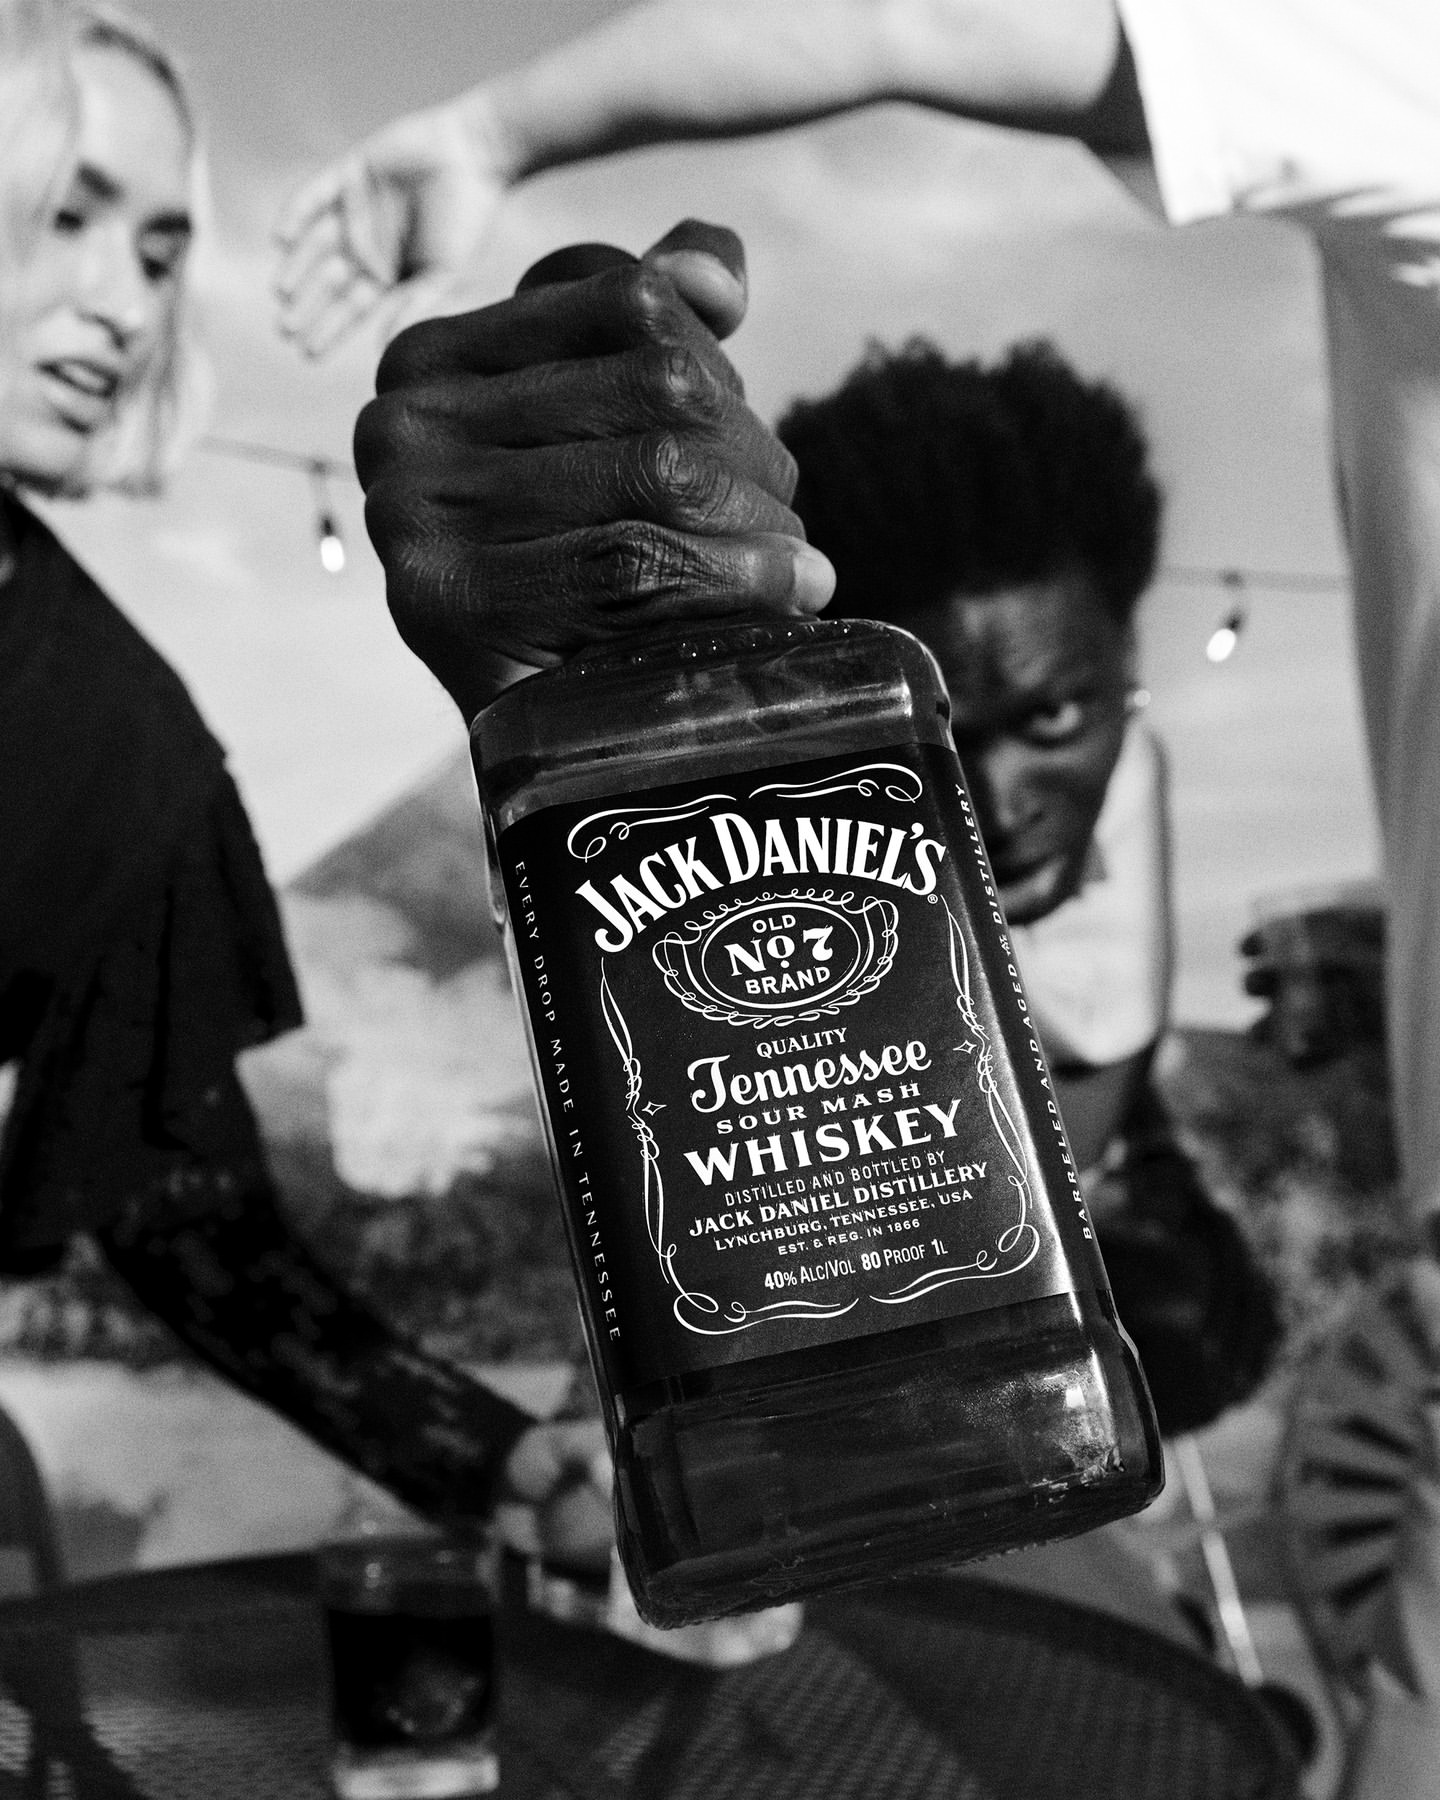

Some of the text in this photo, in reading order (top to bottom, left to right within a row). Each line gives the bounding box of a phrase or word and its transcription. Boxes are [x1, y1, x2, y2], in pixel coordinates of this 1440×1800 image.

[575, 812, 947, 953] JACK DANIEL'S
[954, 784, 1002, 925] DISTILLERY
[752, 914, 797, 934] OLD
[803, 925, 834, 961] 7
[745, 966, 831, 995] BRAND
[1007, 963, 1031, 1026] AGED
[756, 1027, 848, 1058] QUALITY
[1034, 1038, 1052, 1089] AND
[515, 861, 621, 1341] EVERY DROP MADE IN TENNESSEE
[687, 1039, 932, 1112] Tennessee
[717, 1083, 922, 1134] SOUR MASH
[683, 1099, 962, 1186] WHISKEY
[1051, 1100, 1093, 1239] BARRELED
[689, 1162, 988, 1237] JACK DANIEL DISTILLERY
[725, 1151, 945, 1207] DISTILLED AND BOTTLED BY
[715, 1189, 973, 1251] LYNCHBURG, TENNESSEE, USA
[778, 1218, 920, 1255] EST. & REG. IN 1866
[764, 1271, 798, 1289] 40%
[861, 1251, 882, 1271] 80
[931, 1239, 948, 1255] 1L
